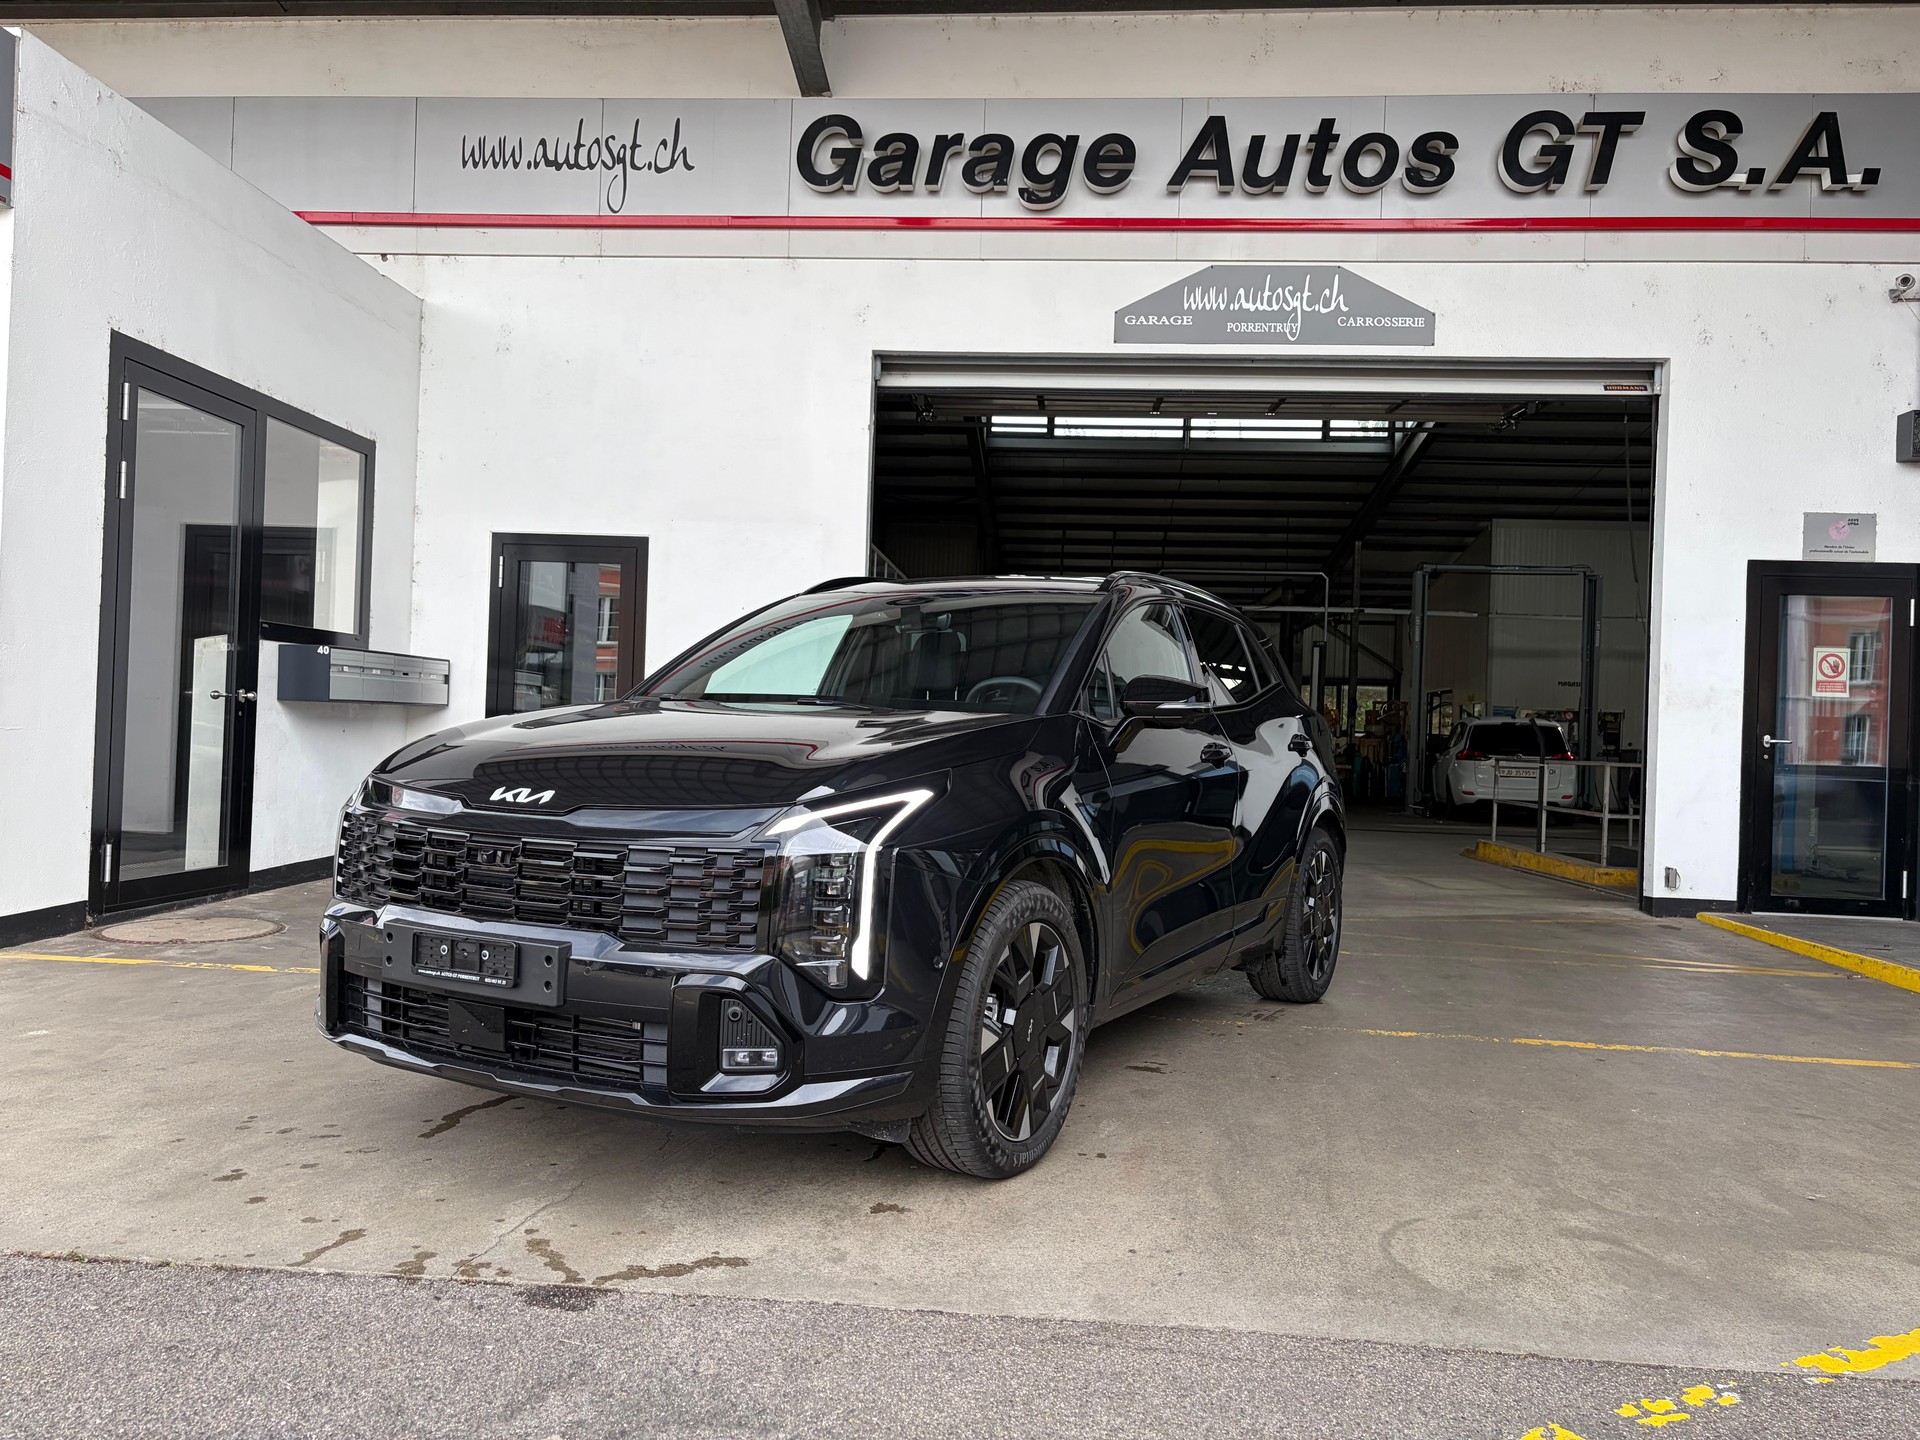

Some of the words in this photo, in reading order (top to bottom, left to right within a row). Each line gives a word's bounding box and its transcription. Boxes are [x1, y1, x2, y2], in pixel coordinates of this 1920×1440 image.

[460, 117, 696, 214] www.autosgt.ch
[796, 114, 1138, 209] Garage
[1166, 115, 1460, 196] Autos
[1498, 109, 1647, 195] GT
[1668, 109, 1882, 195] S.A.
[1183, 273, 1350, 341] www.autosgt.ch
[1123, 315, 1194, 326] GARAGE
[1226, 321, 1299, 334] PORRENTRUY
[1337, 316, 1426, 328] CARROSSERIE
[316, 645, 330, 655] 40
[489, 786, 556, 804] KIA
